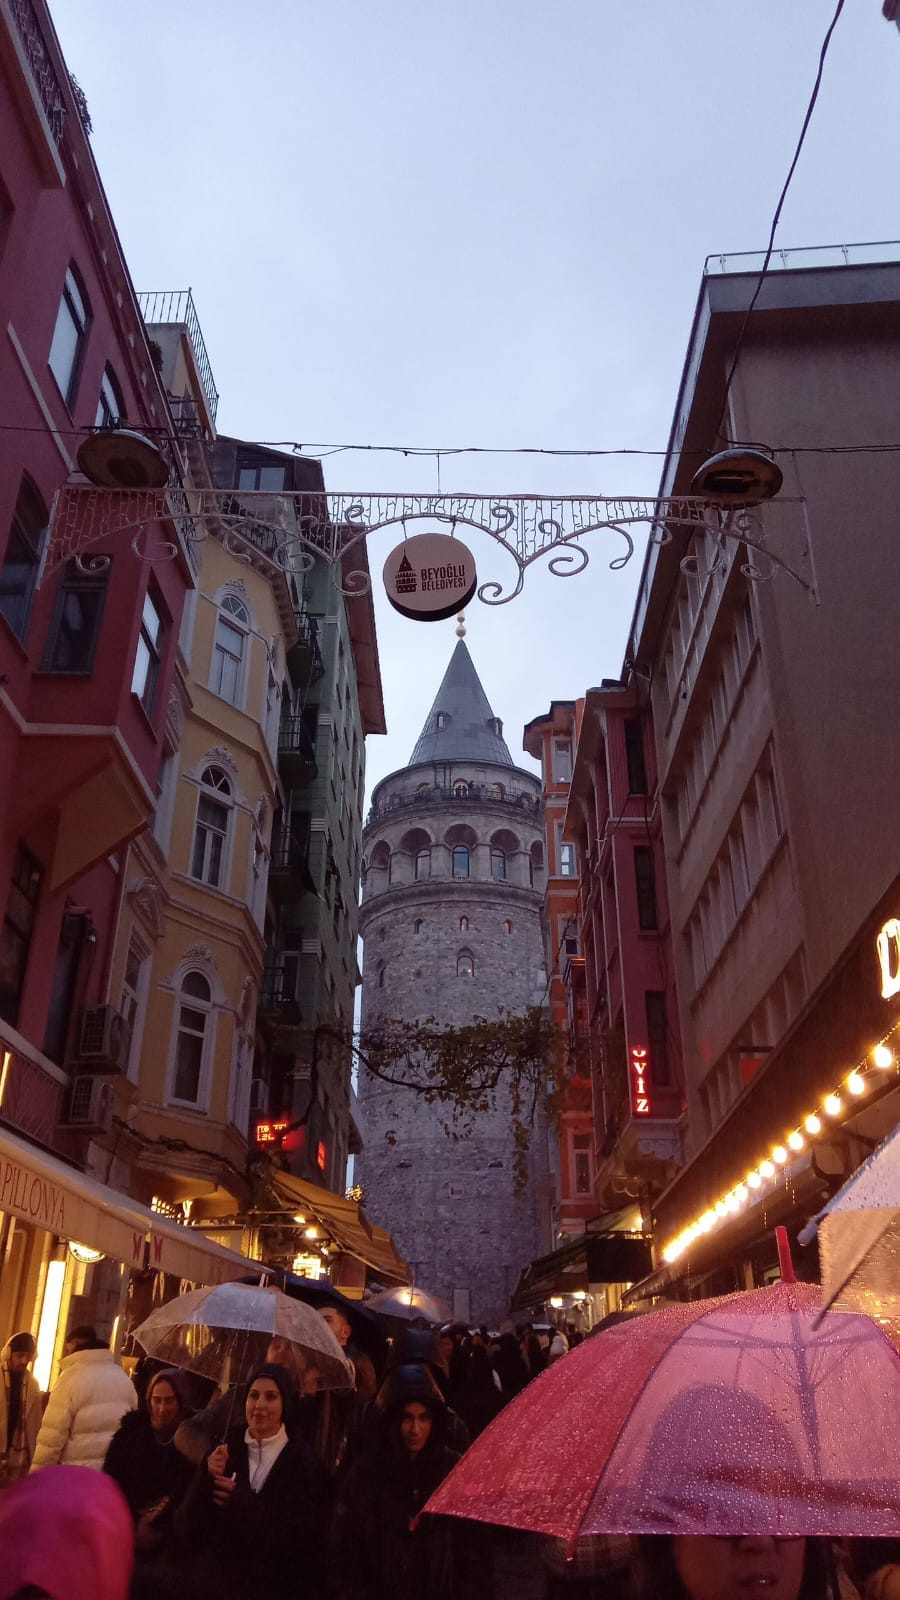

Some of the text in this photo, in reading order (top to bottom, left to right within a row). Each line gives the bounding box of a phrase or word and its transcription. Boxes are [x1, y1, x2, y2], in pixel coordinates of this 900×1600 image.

[421, 564, 465, 580] BEYOĞLU
[421, 577, 466, 591] BELEDİYESİ
[0, 1161, 65, 1229] PILLONYA
